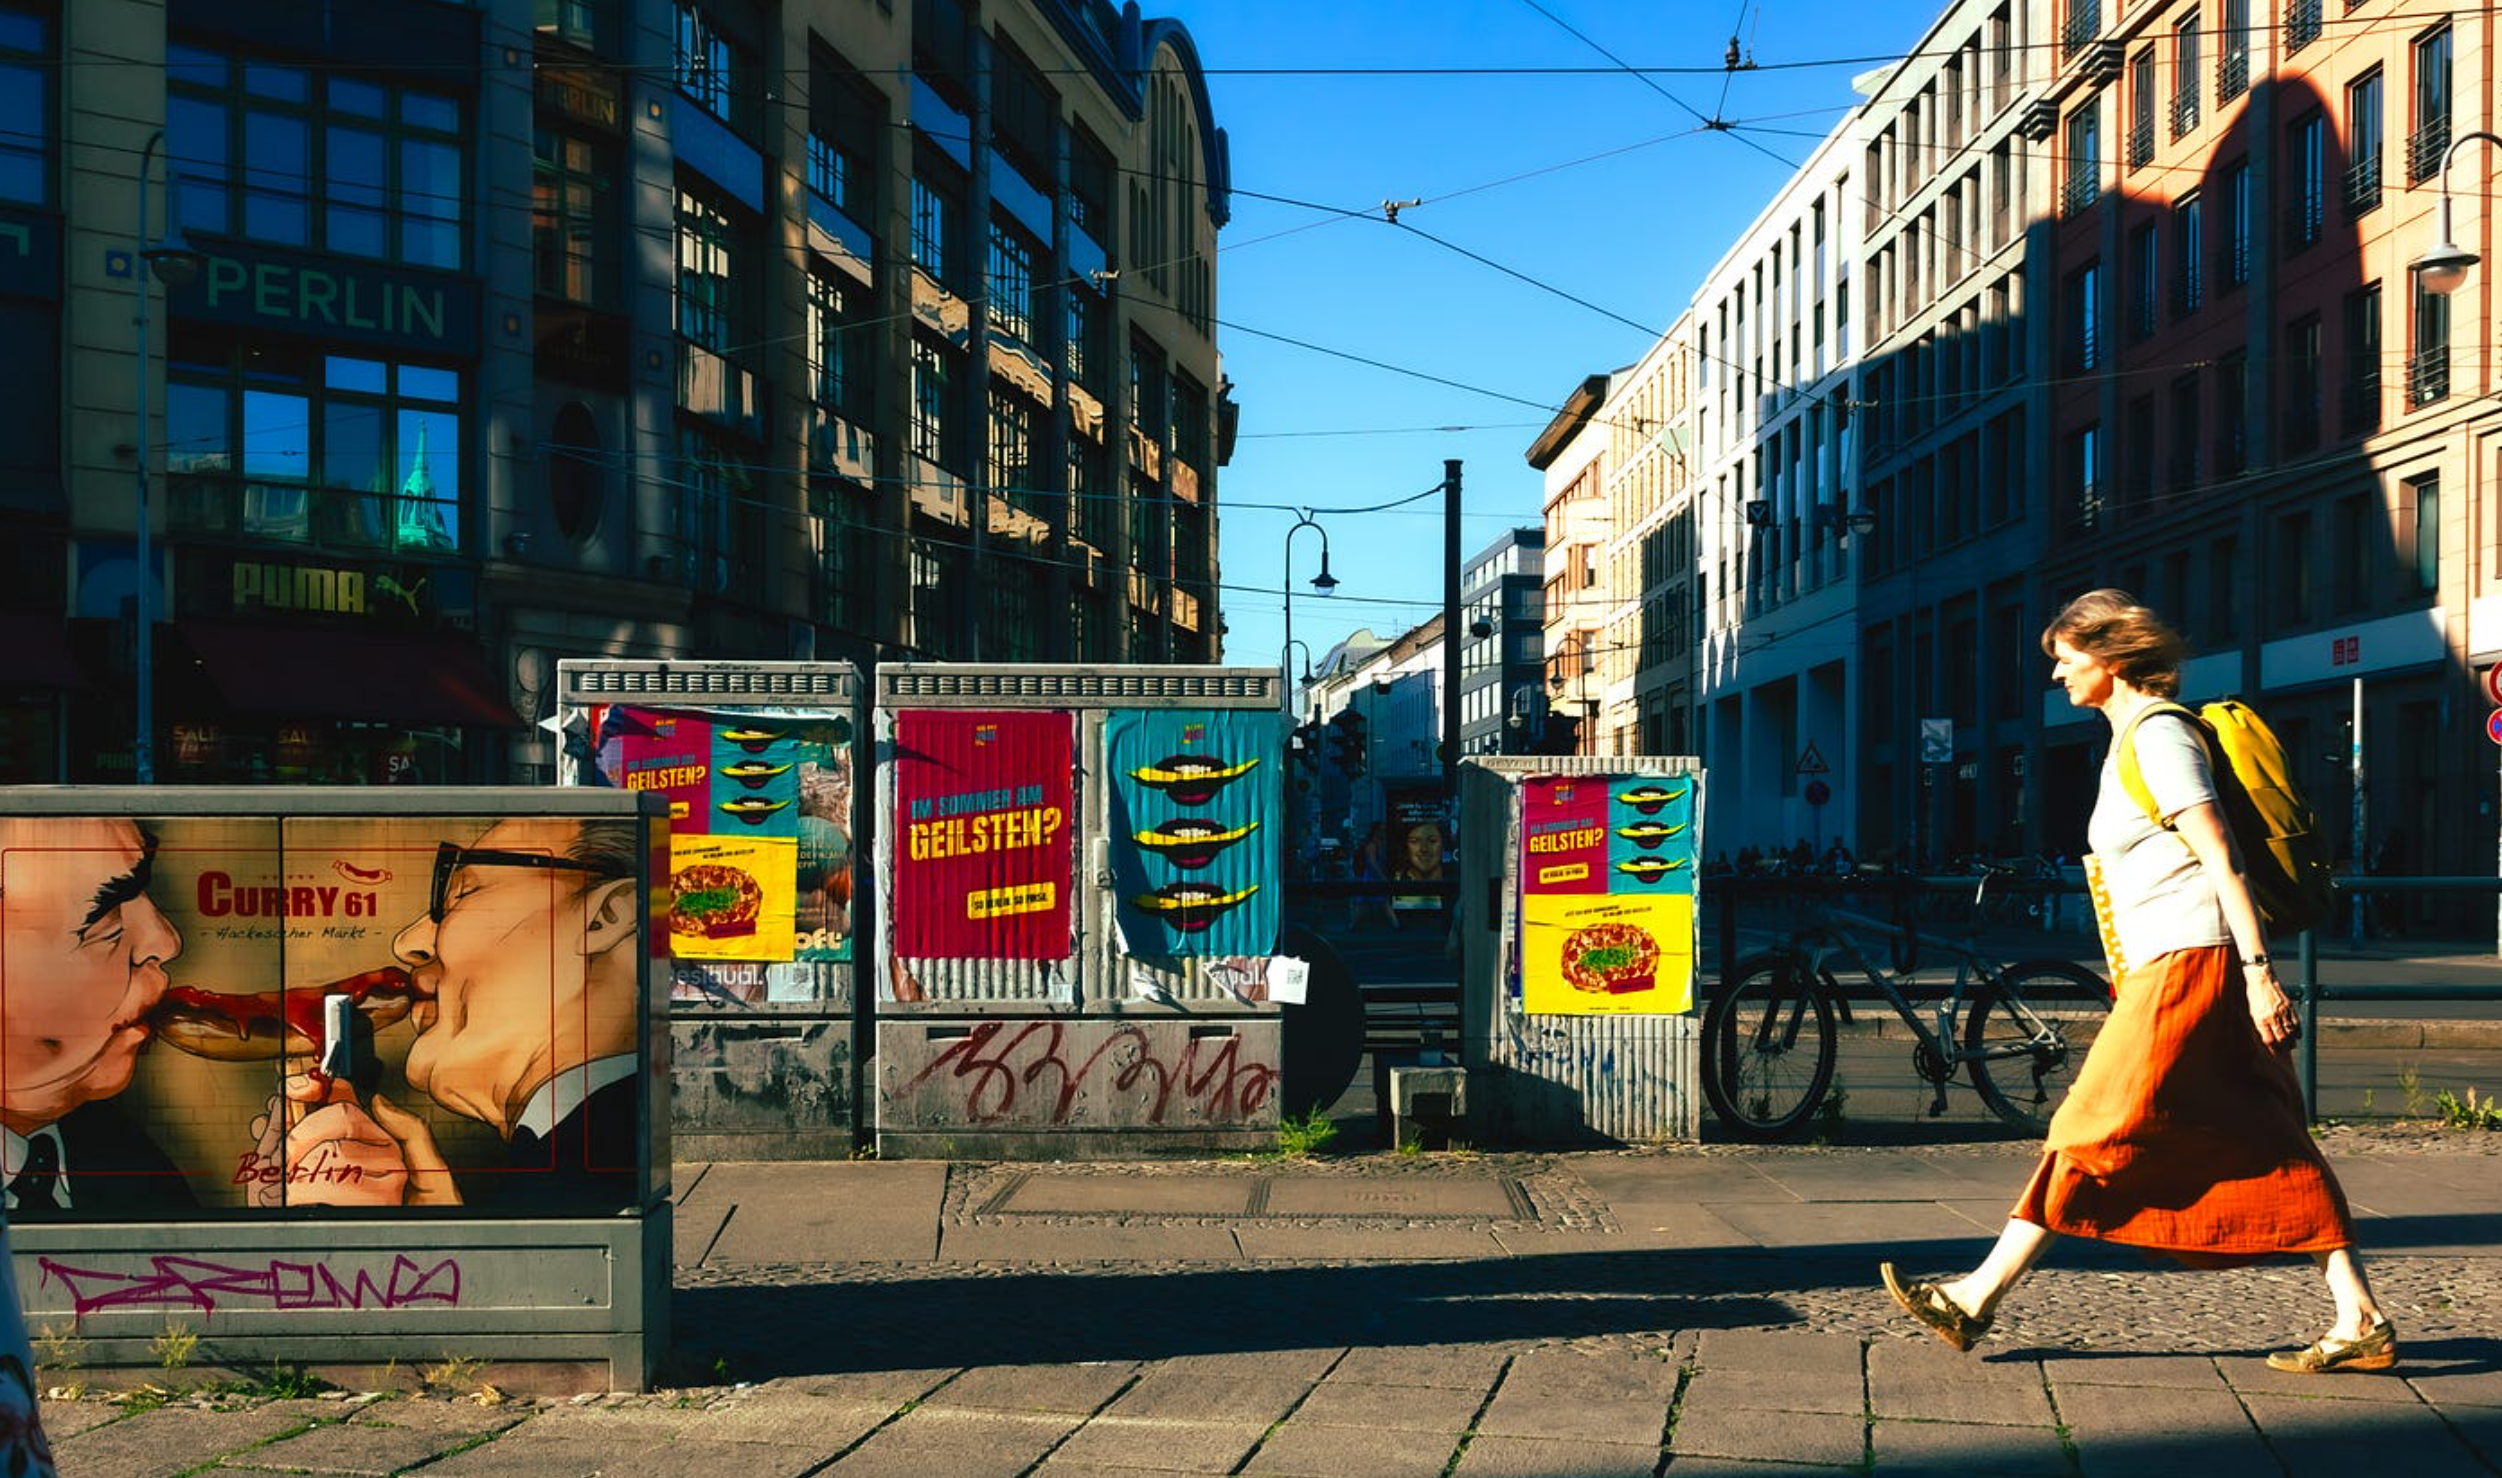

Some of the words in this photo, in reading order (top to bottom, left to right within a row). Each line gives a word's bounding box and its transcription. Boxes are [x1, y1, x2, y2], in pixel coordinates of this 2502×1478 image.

[207, 256, 445, 338] PERLIN
[233, 562, 366, 614] PUMA
[388, 754, 415, 773] SA
[627, 765, 706, 791] GEILSTEN?
[911, 797, 933, 820] IM
[938, 789, 1010, 817] SOMMER
[1015, 783, 1044, 806] AM
[909, 805, 1062, 862] GEILSTEN?
[1529, 826, 1604, 854] GEILSTEN?
[344, 891, 377, 918] 61
[321, 924, 367, 940] Markt
[232, 1148, 364, 1185] Berlin
